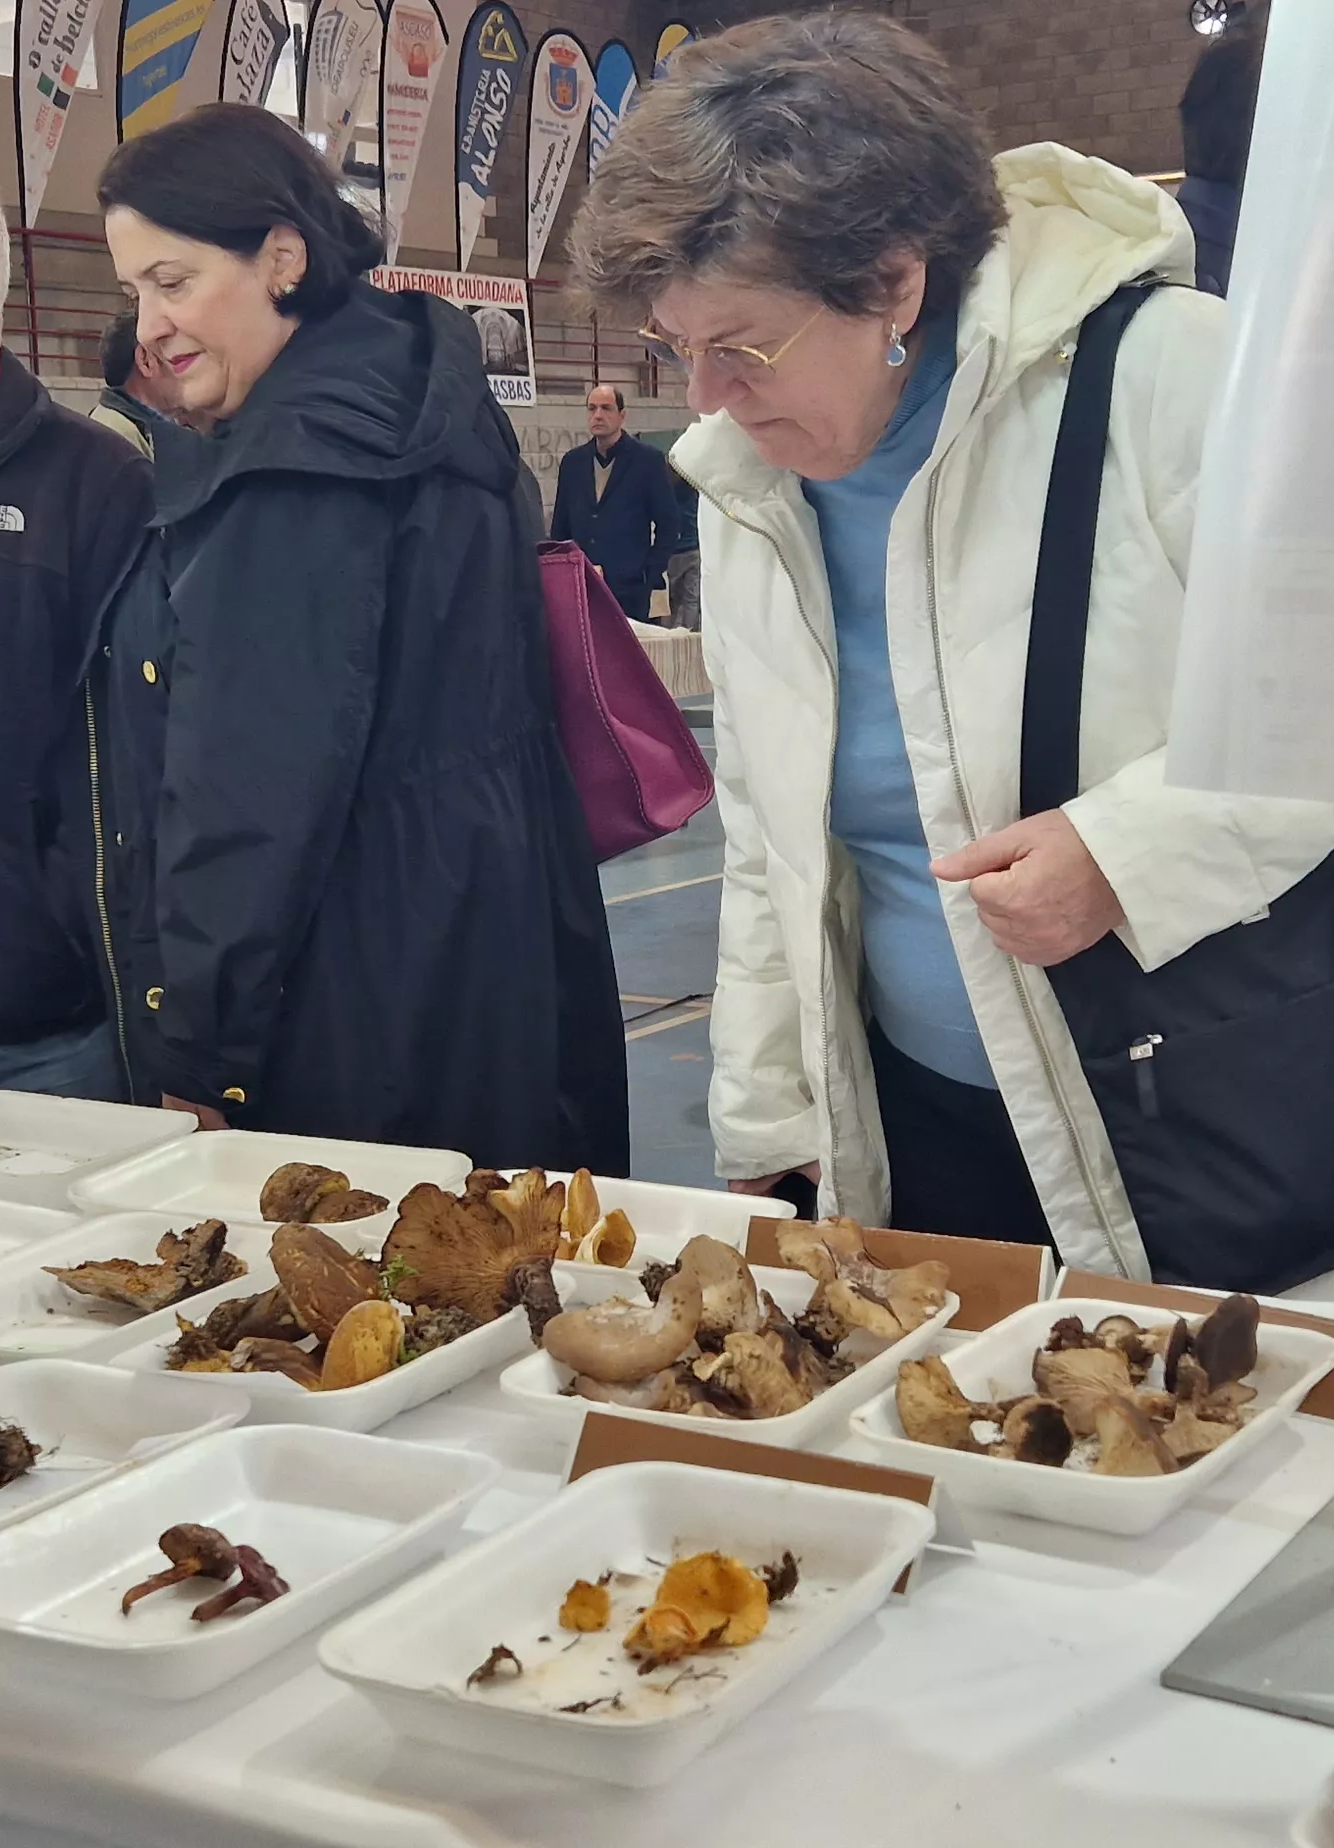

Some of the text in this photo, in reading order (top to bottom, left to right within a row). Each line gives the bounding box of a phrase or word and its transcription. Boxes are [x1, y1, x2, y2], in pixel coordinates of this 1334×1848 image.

[230, 0, 259, 66] Café
[461, 68, 491, 154] EBANISTERIA
[471, 68, 511, 186] ALONSO
[530, 141, 556, 214] Ayuntamiento
[372, 270, 524, 304] PLATAFORMA CIUDADANA
